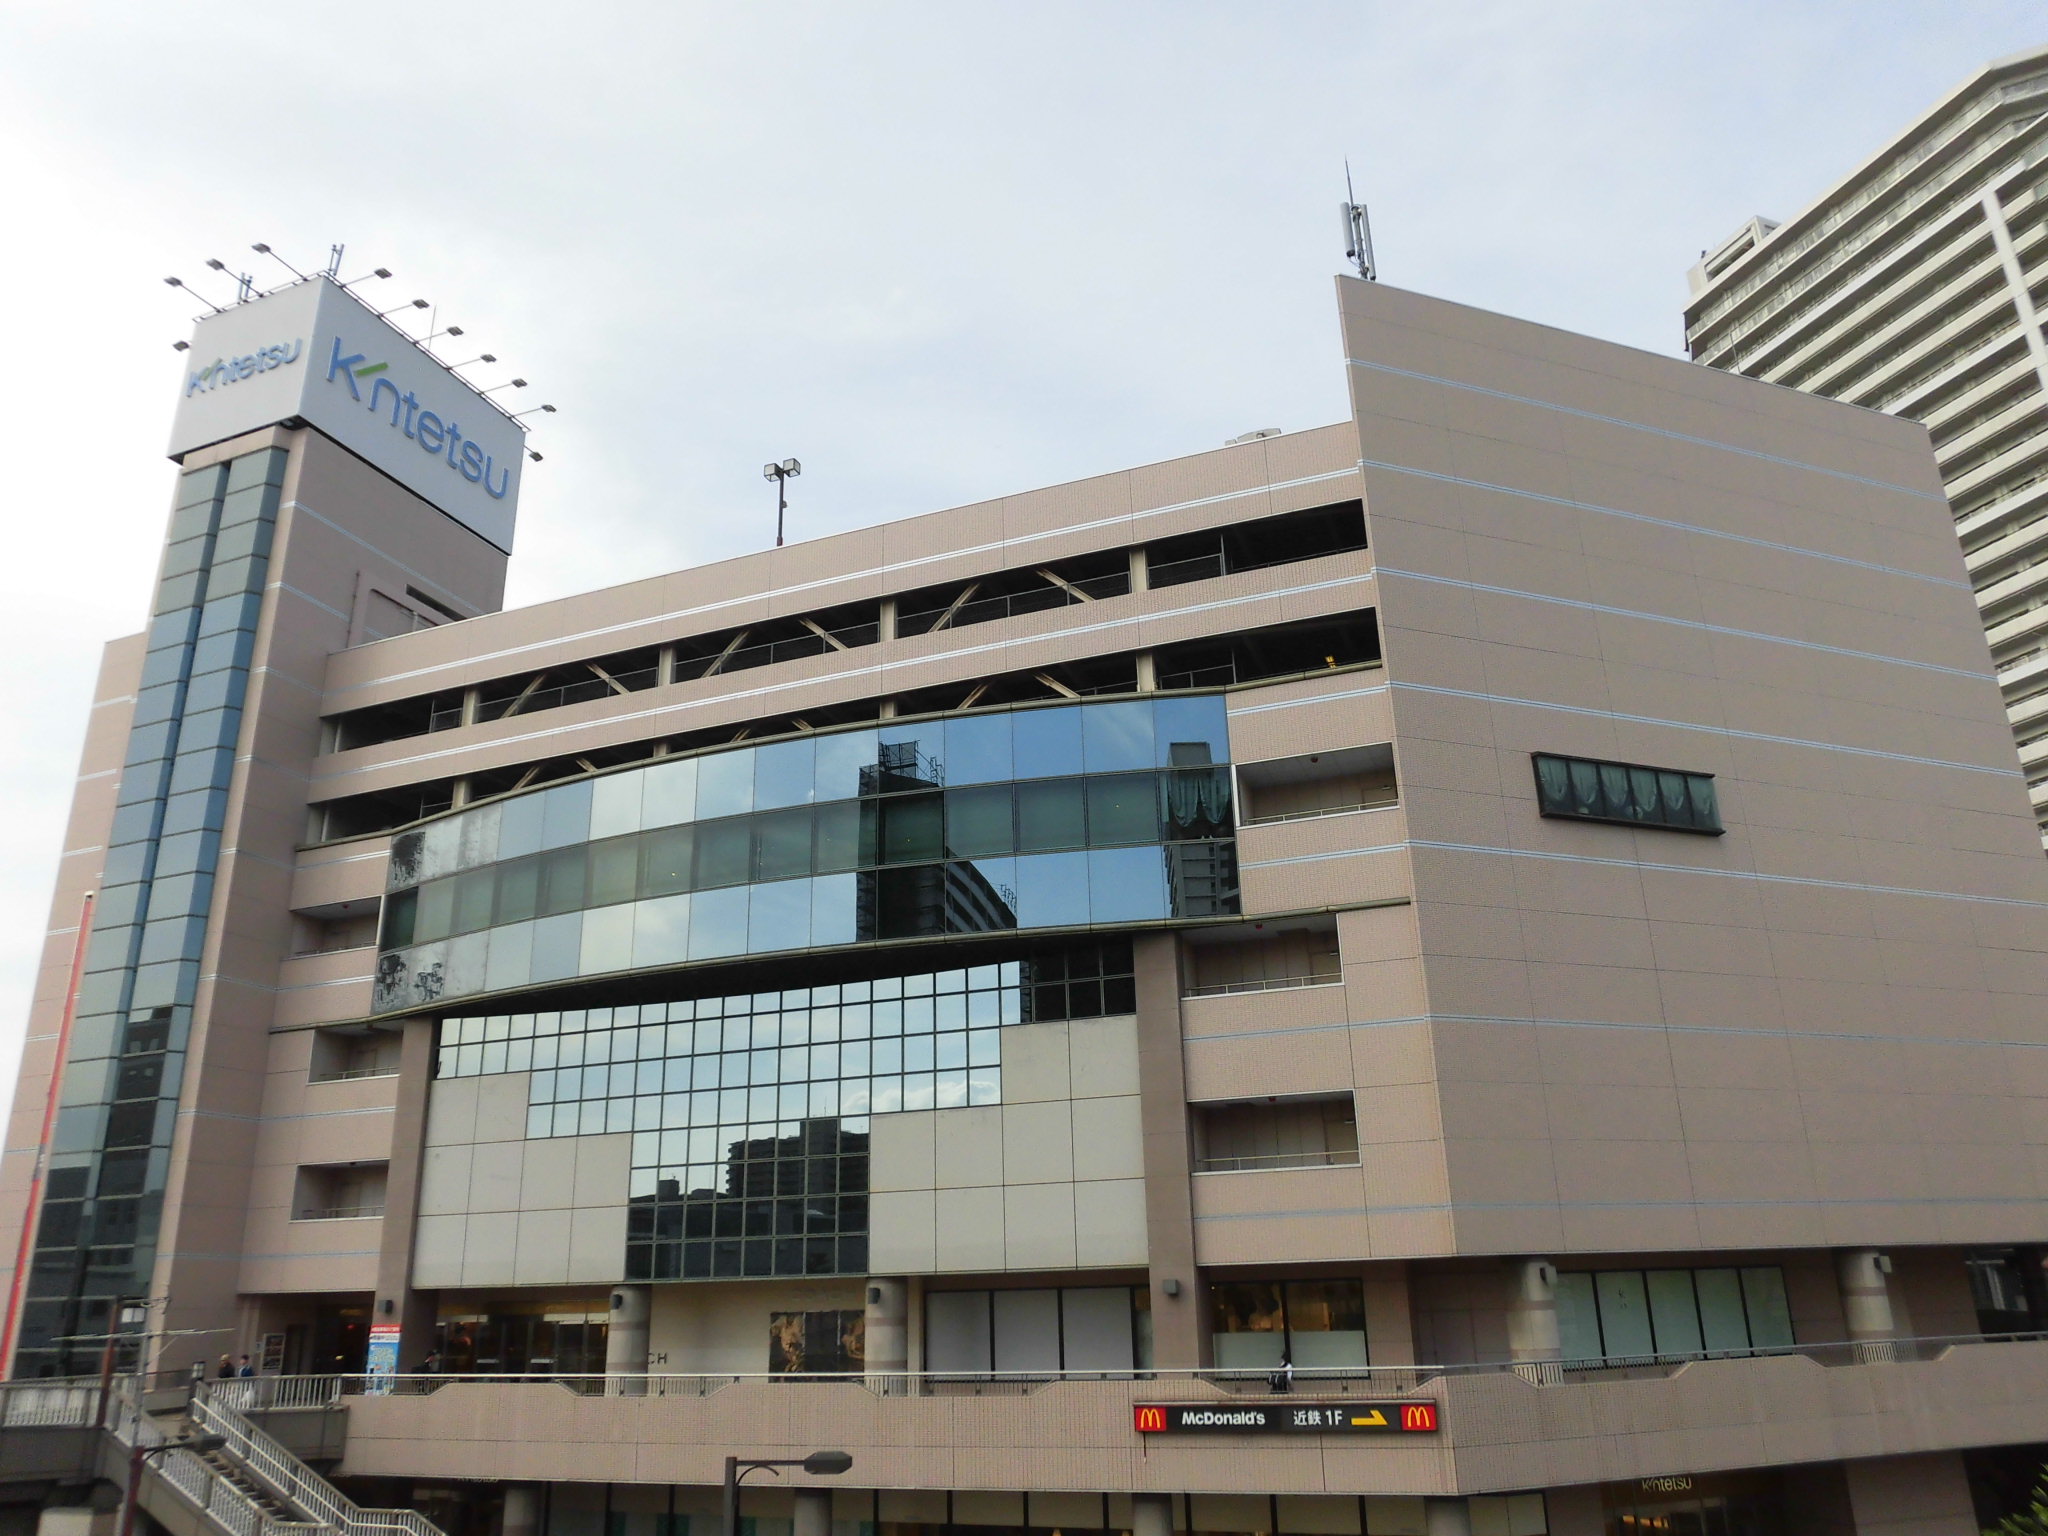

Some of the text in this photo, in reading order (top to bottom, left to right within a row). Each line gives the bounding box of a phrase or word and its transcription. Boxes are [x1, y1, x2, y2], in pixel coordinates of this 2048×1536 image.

[1182, 1411, 1266, 1425] McDonald's
[1293, 1410, 1343, 1426] 近鉄 1F
